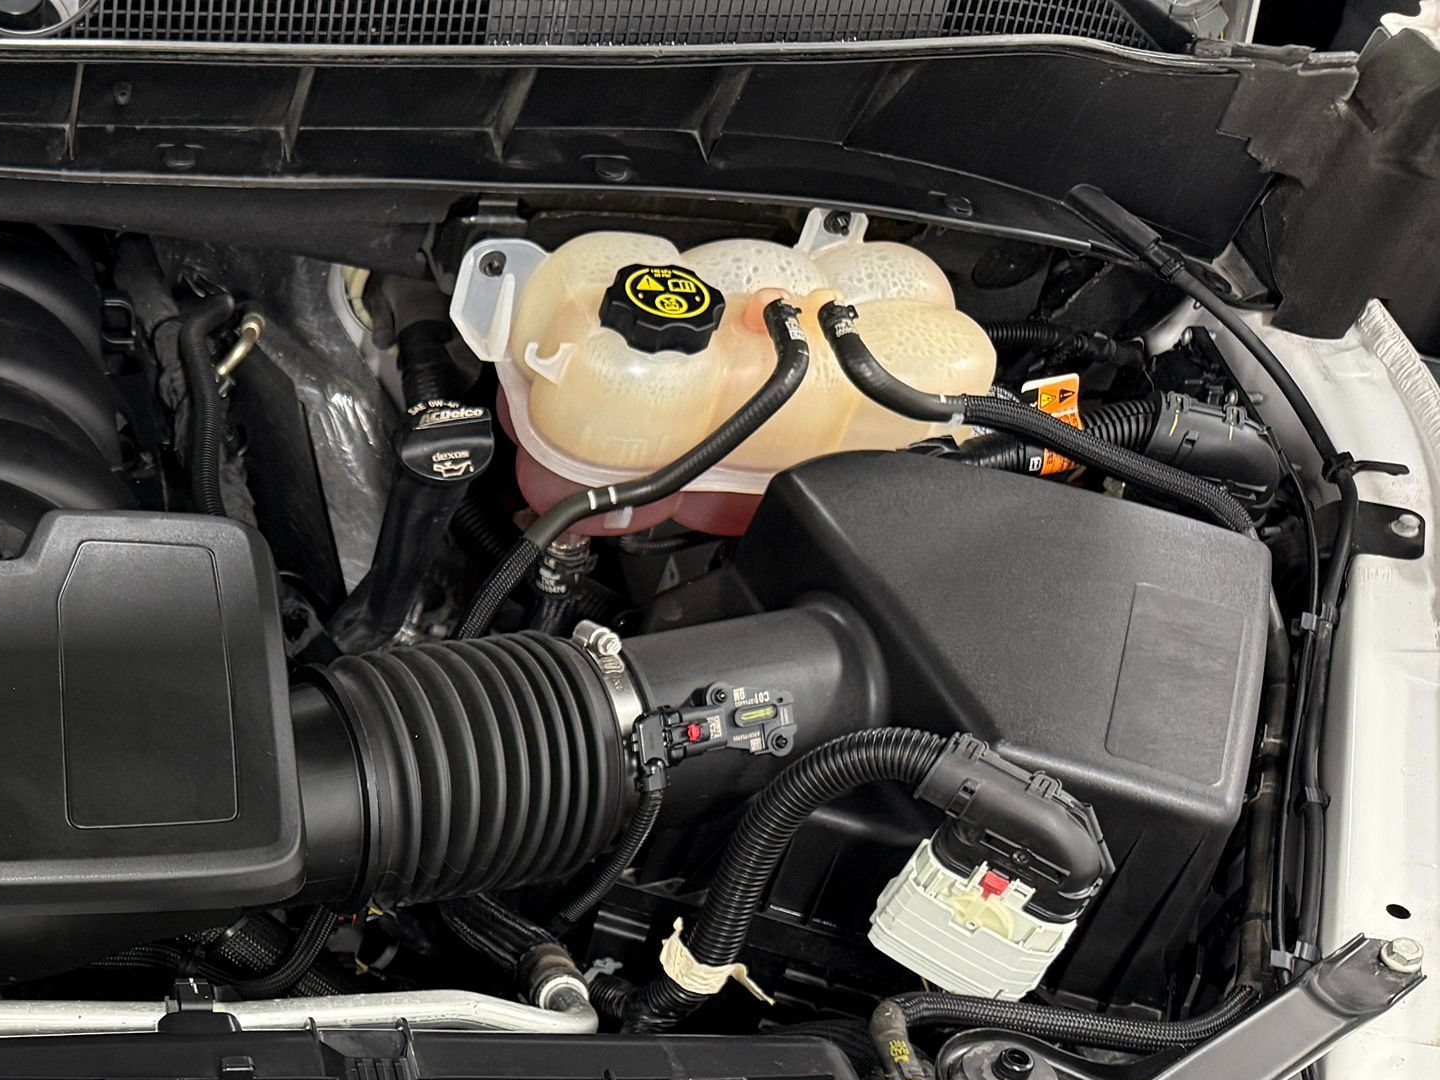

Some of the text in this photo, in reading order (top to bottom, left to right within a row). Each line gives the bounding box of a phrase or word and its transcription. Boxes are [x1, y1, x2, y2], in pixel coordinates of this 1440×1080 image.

[407, 402, 427, 416] SAE
[419, 407, 484, 425] ACDelco
[432, 450, 471, 462] dexos
